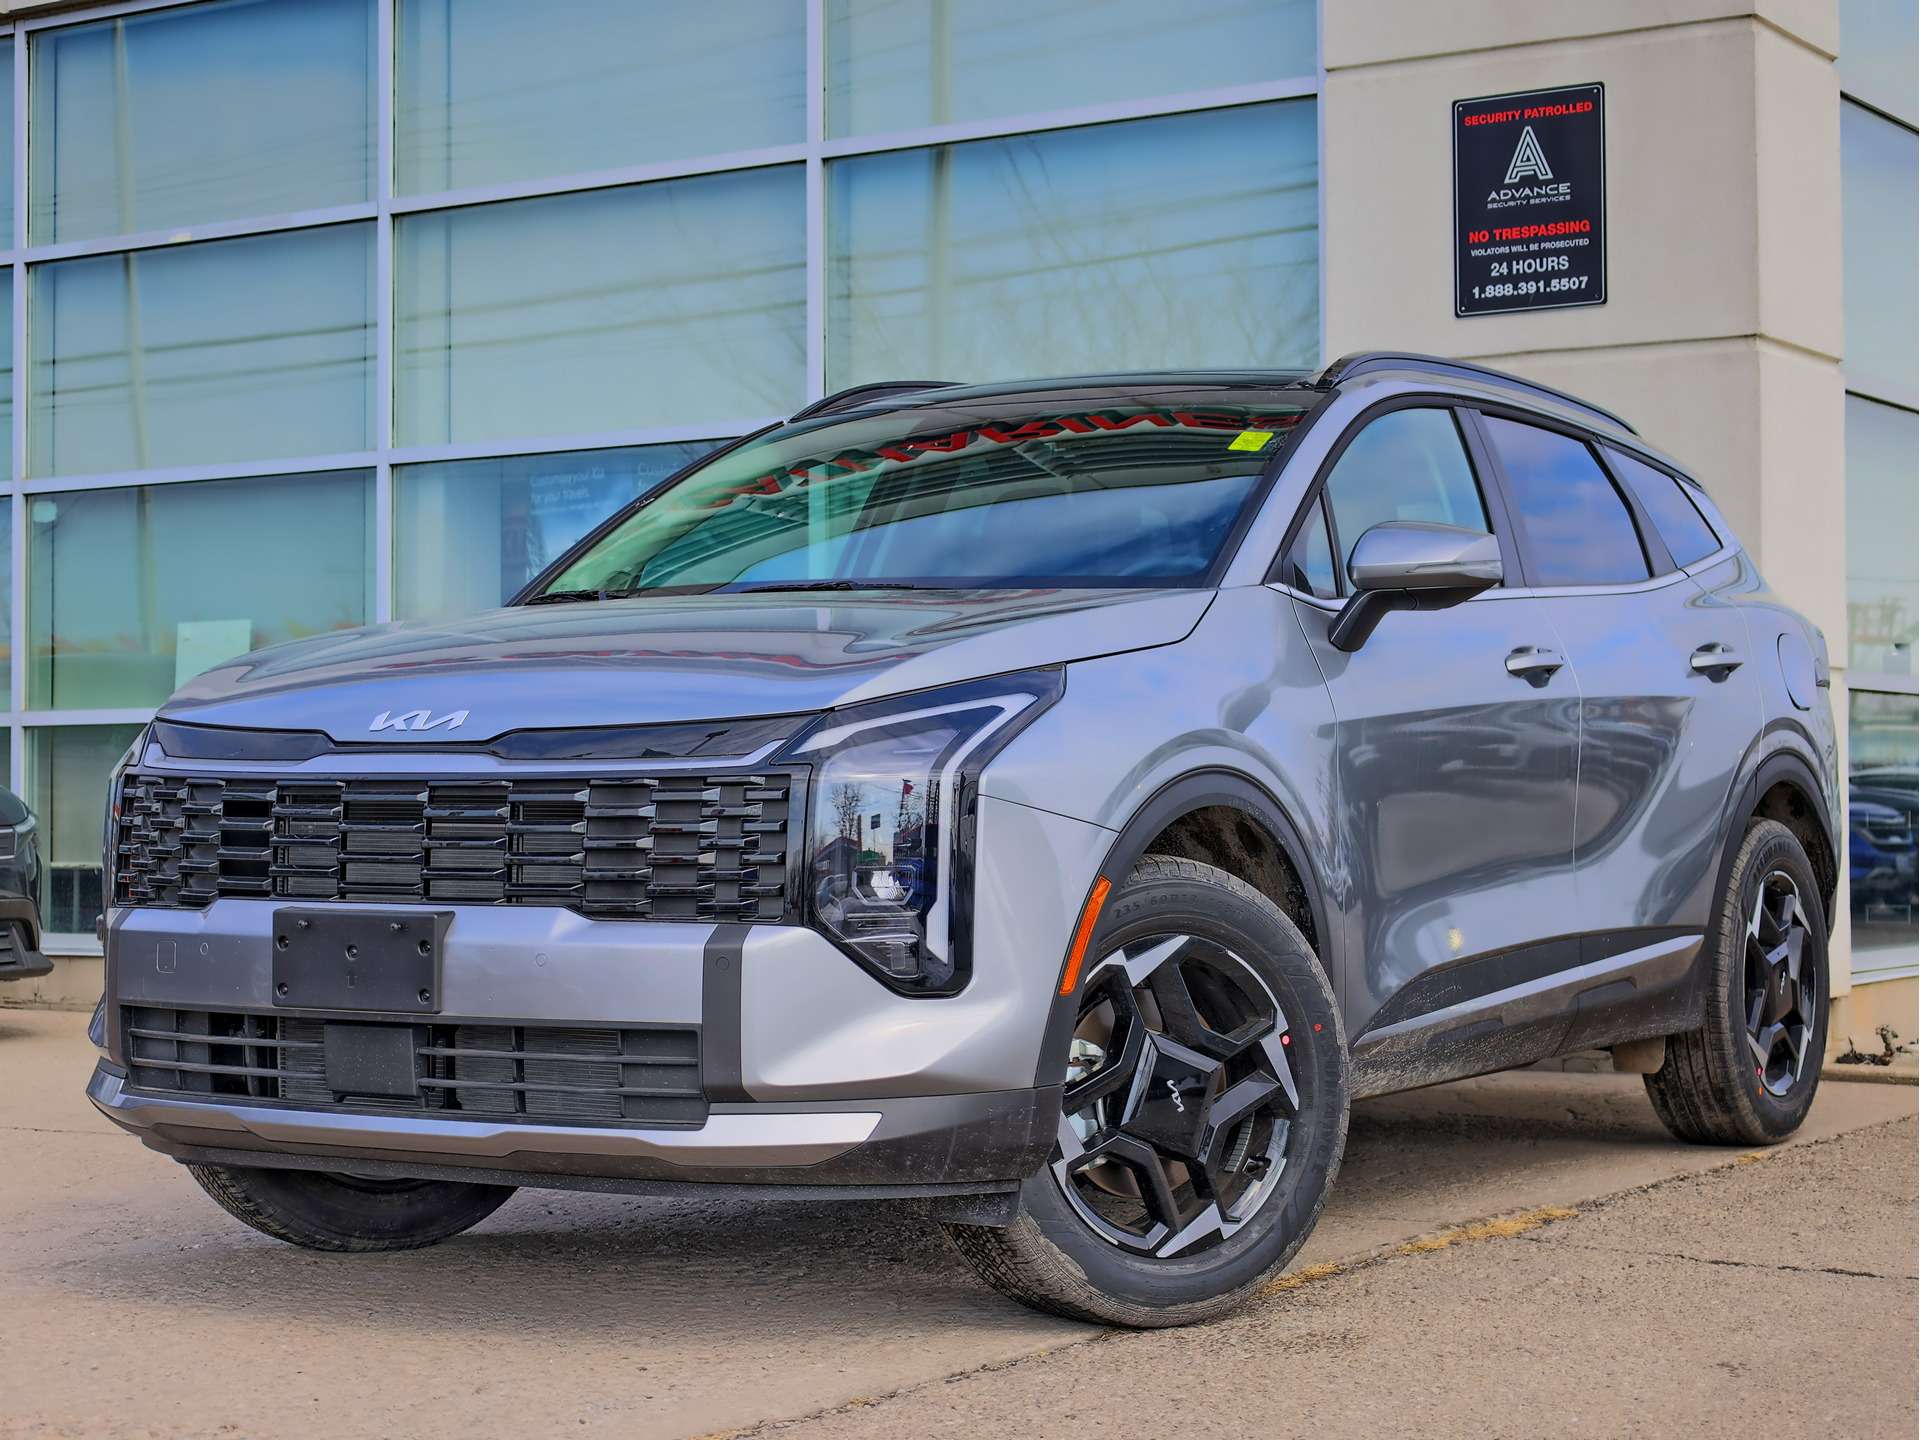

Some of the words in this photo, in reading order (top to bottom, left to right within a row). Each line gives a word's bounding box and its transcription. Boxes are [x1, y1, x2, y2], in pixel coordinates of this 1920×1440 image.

[1464, 110, 1521, 126] SECURITY
[1524, 101, 1593, 119] PATROLLED
[1487, 182, 1571, 201] ADVANCE
[1487, 199, 1527, 209] SECURITY
[1529, 194, 1571, 205] SERVICES
[1469, 230, 1490, 244] NO
[1493, 219, 1591, 241] TRESPASSING
[1471, 246, 1510, 257] VIOLATORS
[1511, 243, 1528, 252] WILL
[1530, 242, 1539, 251] BE
[1540, 238, 1590, 250] PROSECUTED
[1490, 262, 1508, 277] 24
[1512, 255, 1569, 275] HOURS
[1472, 276, 1589, 299] 1.888.391.5507
[369, 709, 470, 732] KIA
